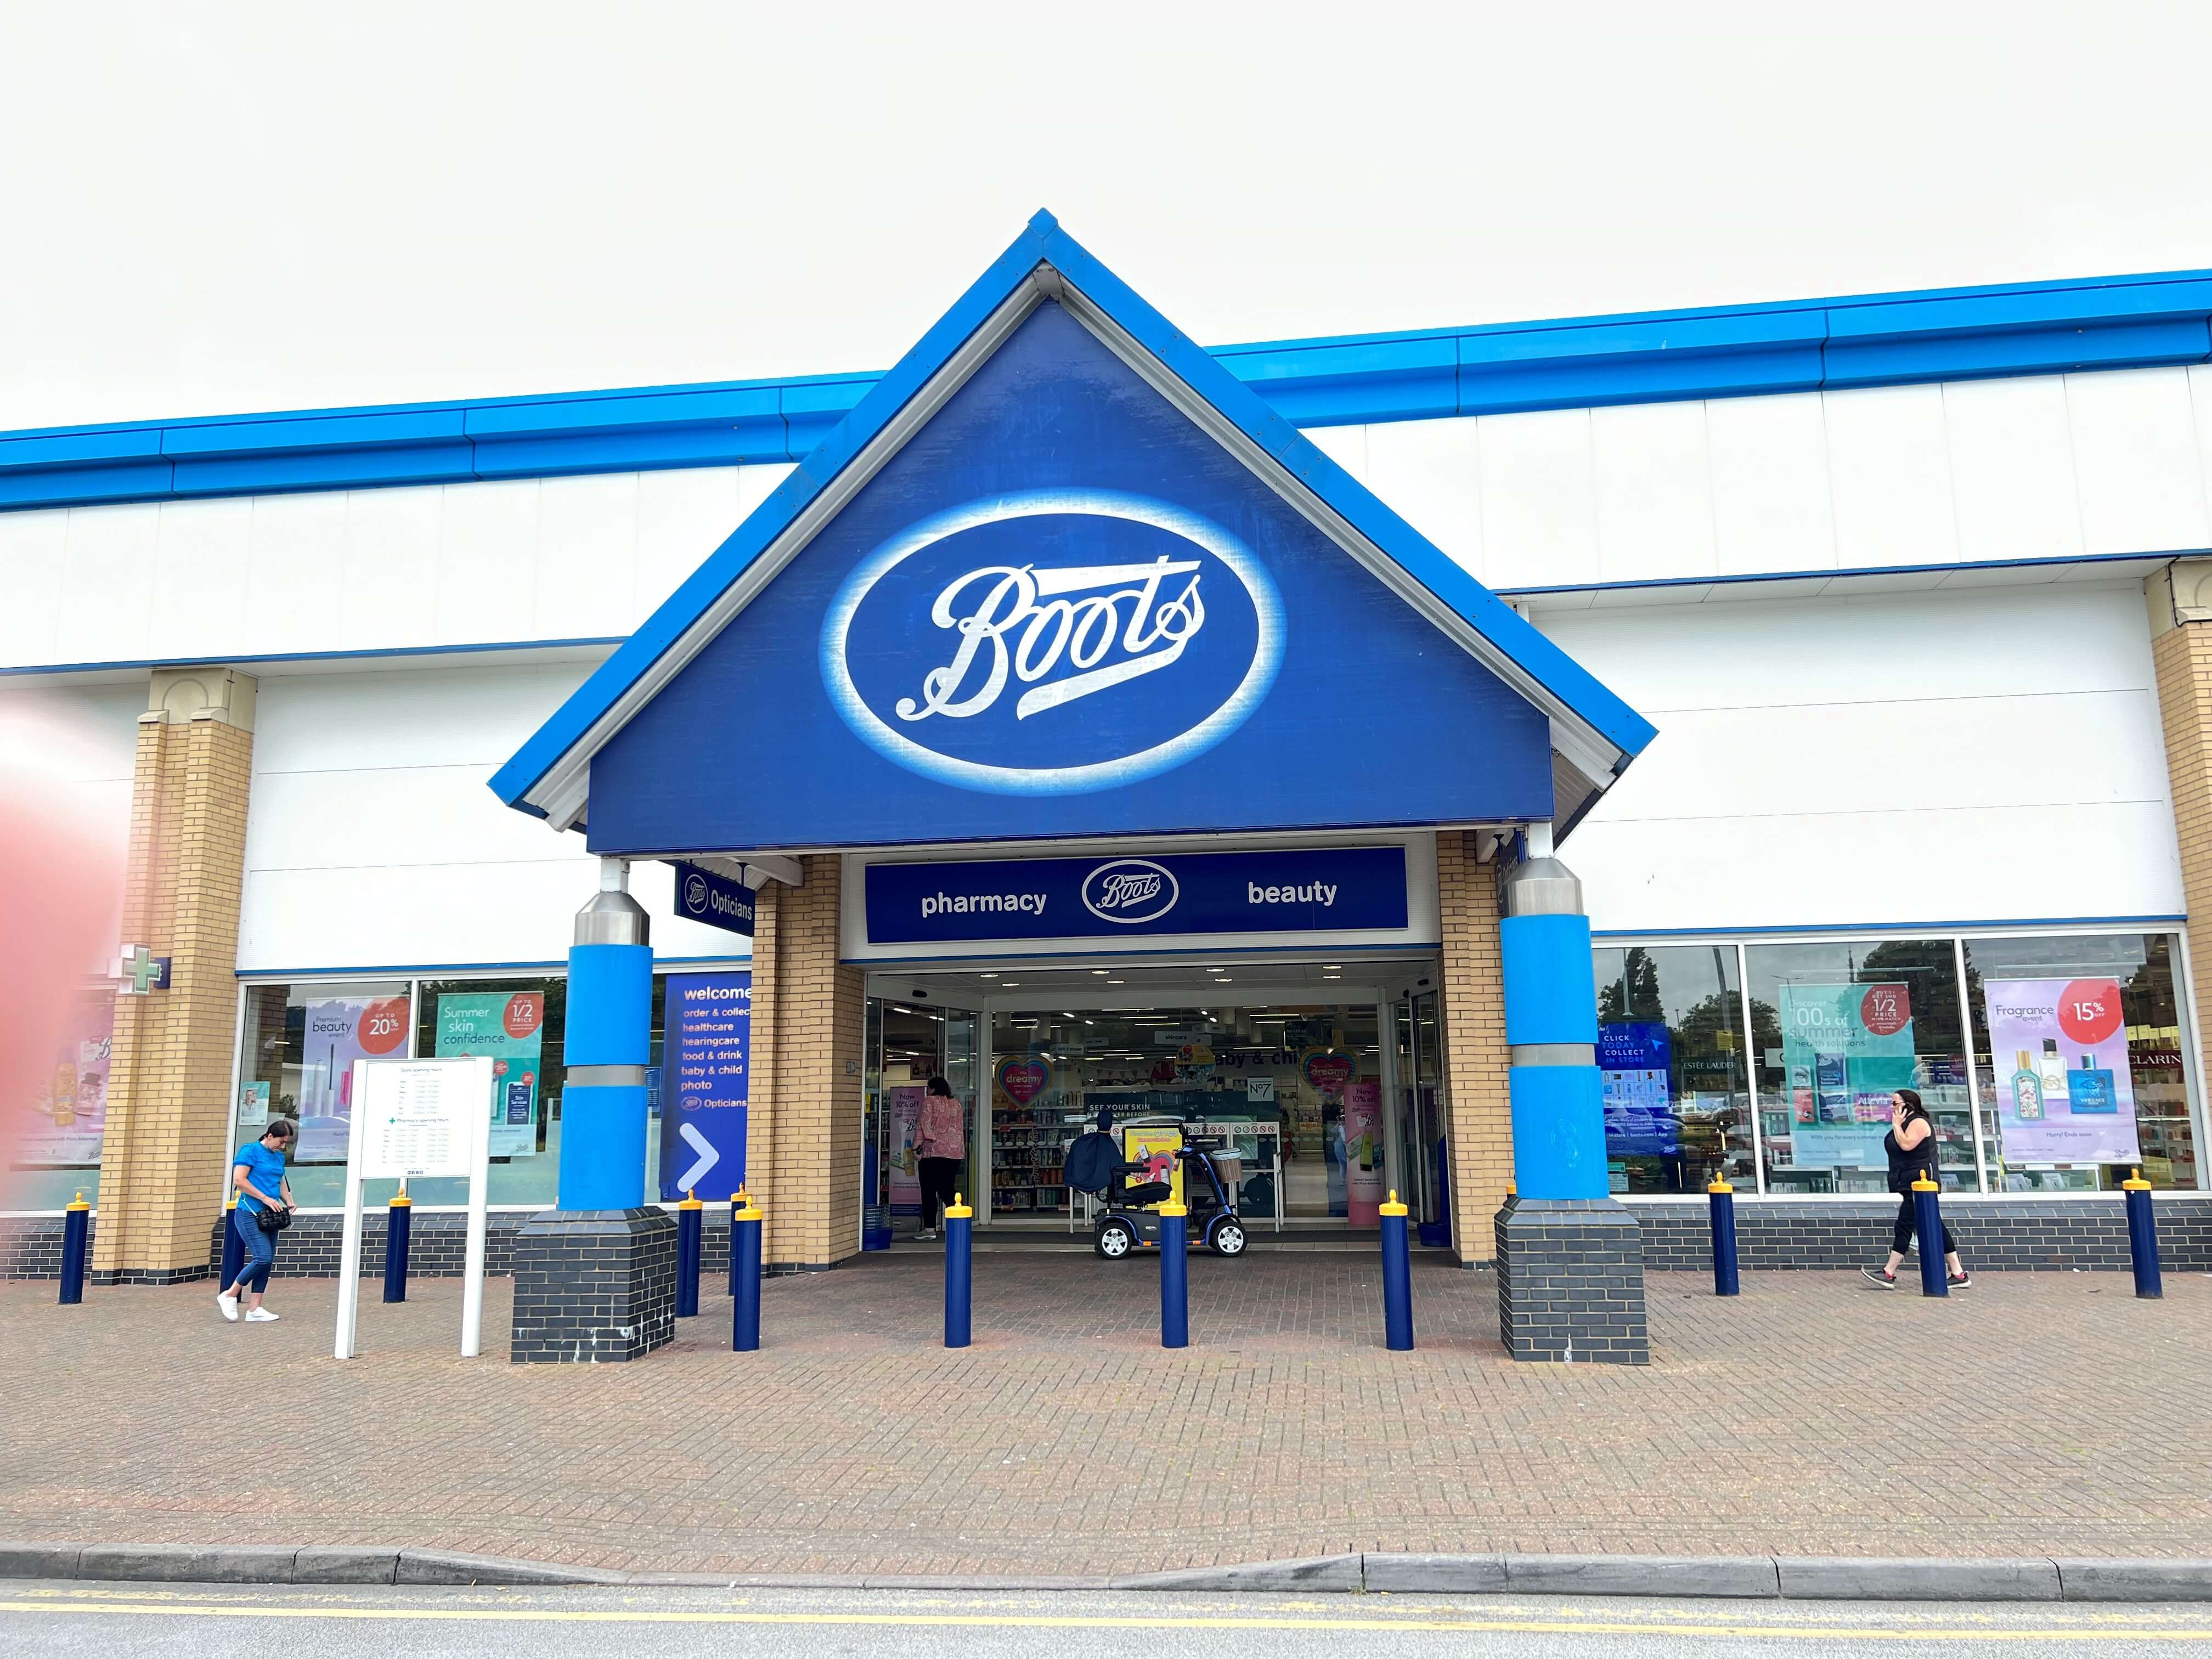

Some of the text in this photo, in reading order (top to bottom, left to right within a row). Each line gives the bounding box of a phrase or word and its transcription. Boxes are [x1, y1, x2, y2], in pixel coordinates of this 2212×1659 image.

[895, 555, 1205, 721] Boots
[1096, 873, 1161, 909] Boots
[1248, 881, 1338, 906] beauty
[711, 889, 753, 921] Opticians
[922, 891, 1047, 918] pharmacy
[684, 986, 752, 1001] welcome
[513, 1004, 533, 1018] 1/2
[1874, 998, 1897, 1012] 1/2
[1995, 1005, 2055, 1018] Fragrance
[2073, 1002, 2104, 1021] 15%
[444, 1006, 490, 1018] Summer
[684, 1007, 751, 1018] order & collec
[312, 1021, 353, 1034] beauty
[369, 1018, 399, 1035] 20%
[448, 1019, 473, 1032] skin
[682, 1022, 734, 1032] healthcare
[1790, 1026, 1858, 1038] summer
[443, 1032, 505, 1045] confidence
[682, 1036, 740, 1047] hearingcare
[1795, 1039, 1865, 1047] health solutions
[682, 1050, 742, 1060] food & drink
[1215, 1048, 1297, 1069] aby & chi
[2129, 1054, 2181, 1064] CLARIN
[681, 1064, 743, 1077] baby & child
[680, 1080, 713, 1092] photo
[1006, 1074, 1042, 1085] dreamy
[704, 1098, 747, 1109] Opticians
